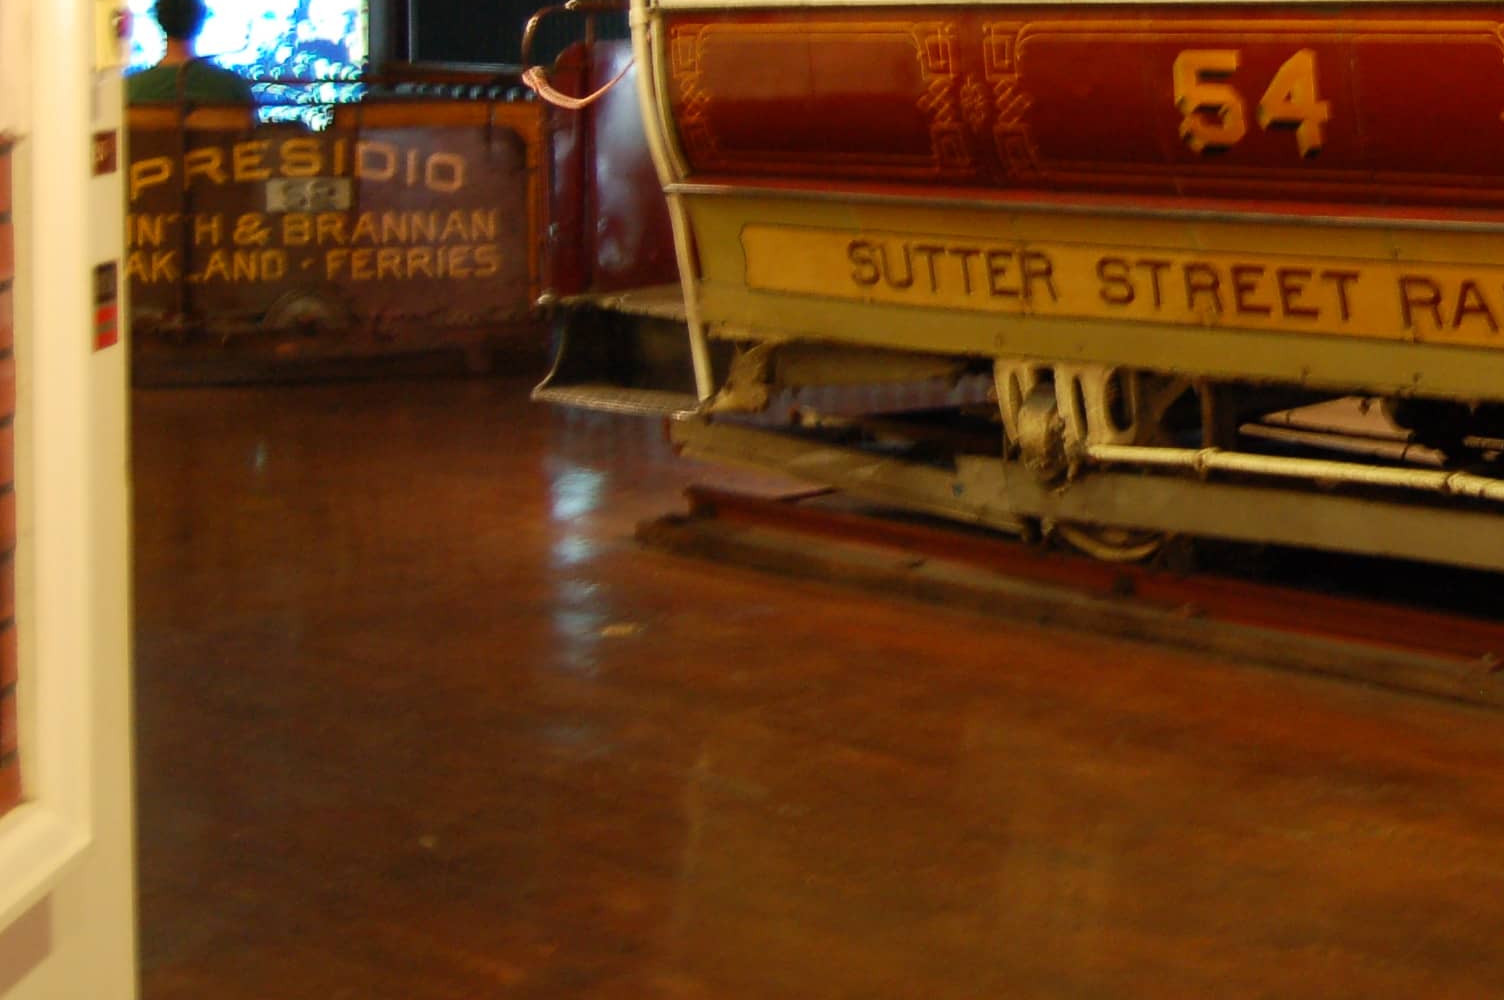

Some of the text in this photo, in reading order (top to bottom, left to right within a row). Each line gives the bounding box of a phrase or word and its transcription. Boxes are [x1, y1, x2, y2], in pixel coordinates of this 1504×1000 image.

[1173, 48, 1331, 158] 54
[130, 137, 466, 201] PRESIDIO
[232, 213, 272, 245] &
[282, 207, 500, 246] BRANNAN
[325, 244, 499, 280] FERRIES
[847, 240, 1059, 302] SUTTER
[1096, 256, 1361, 322] STREET
